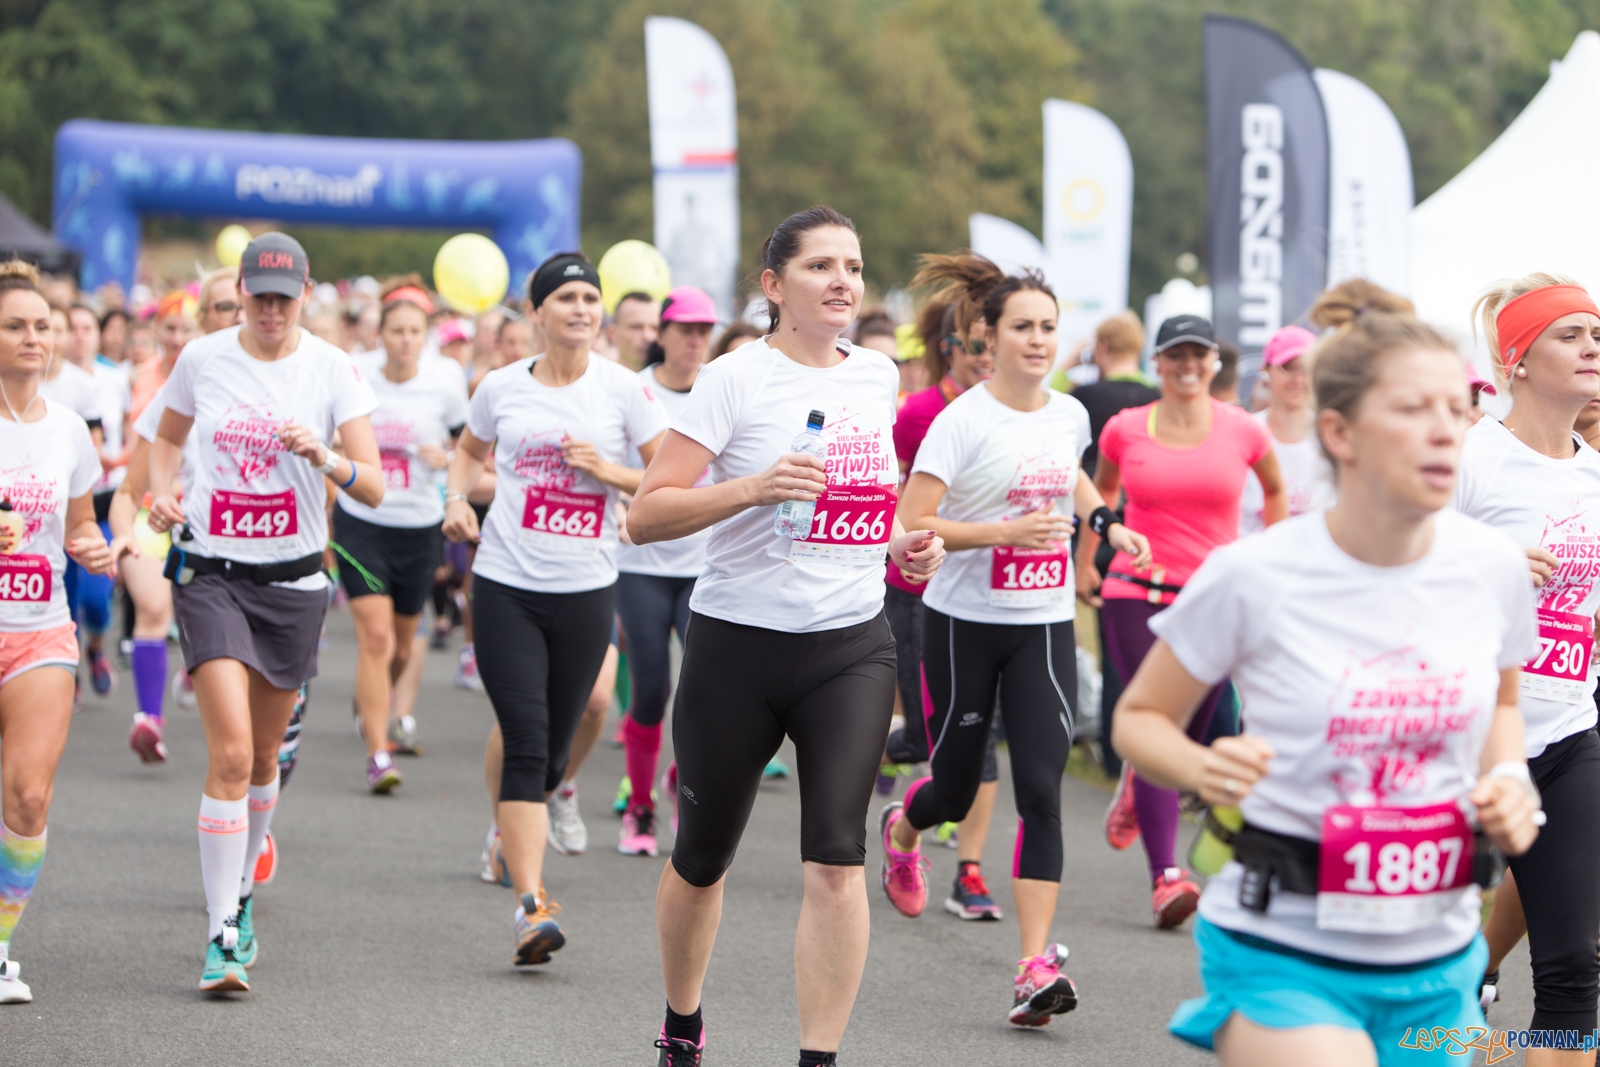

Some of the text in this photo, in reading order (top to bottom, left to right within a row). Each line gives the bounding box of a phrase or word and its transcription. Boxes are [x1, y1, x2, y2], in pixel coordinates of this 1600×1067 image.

[258, 250, 293, 270] RUN
[827, 440, 880, 456] awsze
[824, 453, 889, 479] er(w)si!
[0, 487, 53, 500] awsze
[220, 509, 290, 537] 1449
[532, 505, 597, 537] 1662
[811, 510, 886, 541] 1666
[1003, 560, 1062, 588] 1663
[1520, 636, 1585, 676] 730
[1343, 836, 1463, 894] 1887
